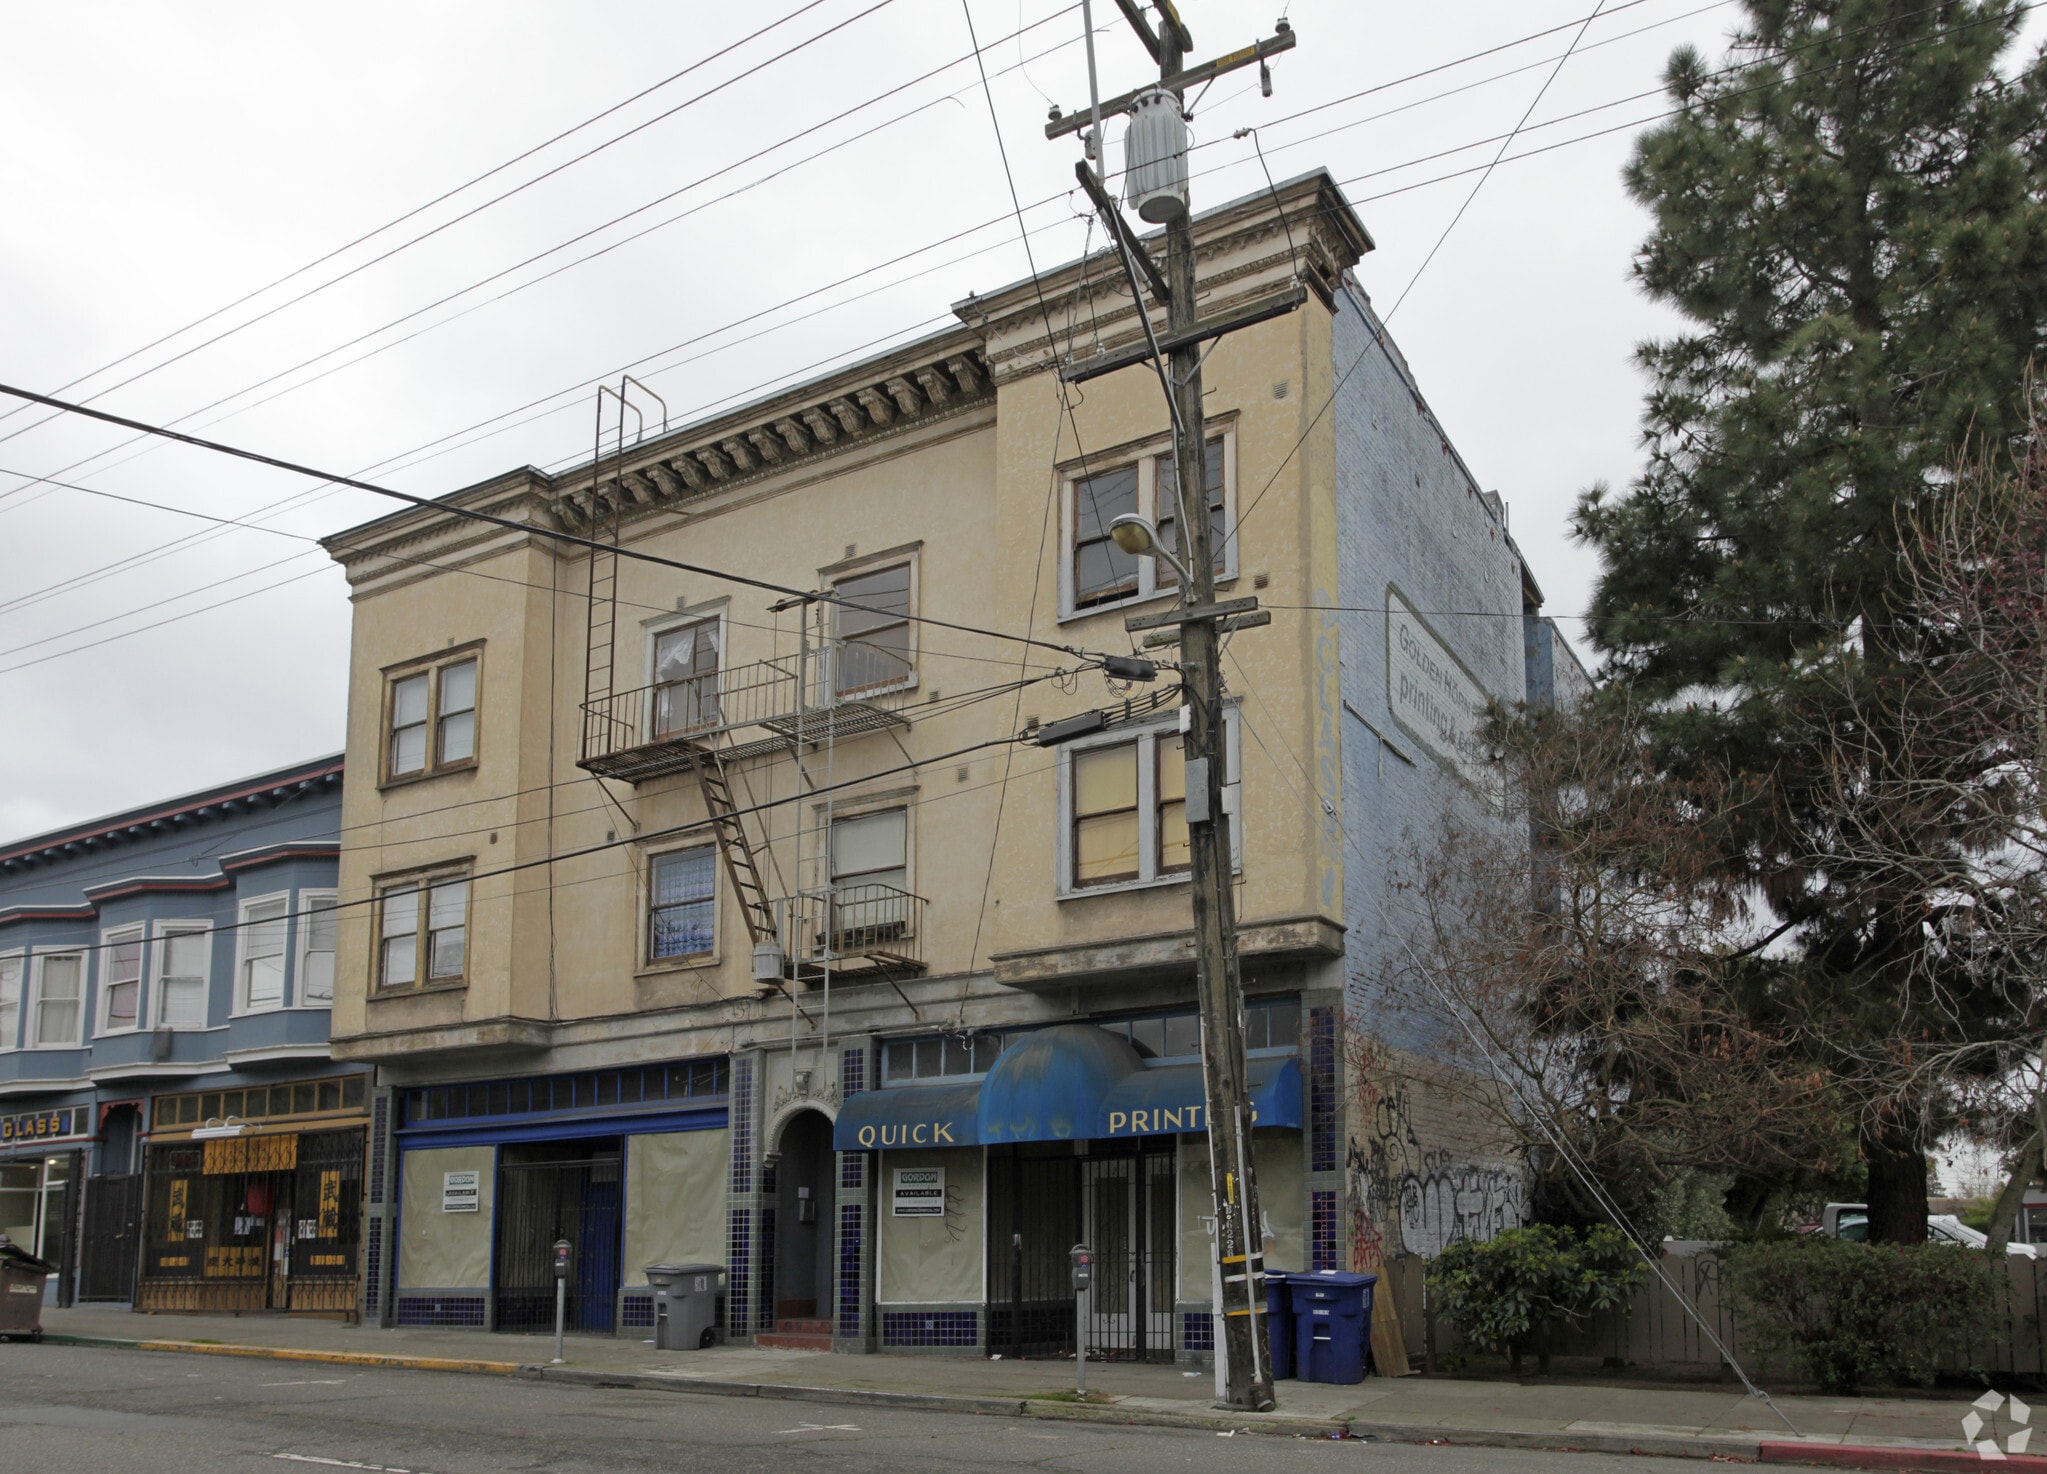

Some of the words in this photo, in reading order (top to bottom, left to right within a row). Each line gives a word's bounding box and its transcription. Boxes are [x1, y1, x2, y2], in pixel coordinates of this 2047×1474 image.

[2, 1116, 61, 1138] GLASS
[1109, 1101, 1258, 1134] PRINTI
[857, 1121, 955, 1149] QUICK
[902, 1172, 938, 1183] GORDON
